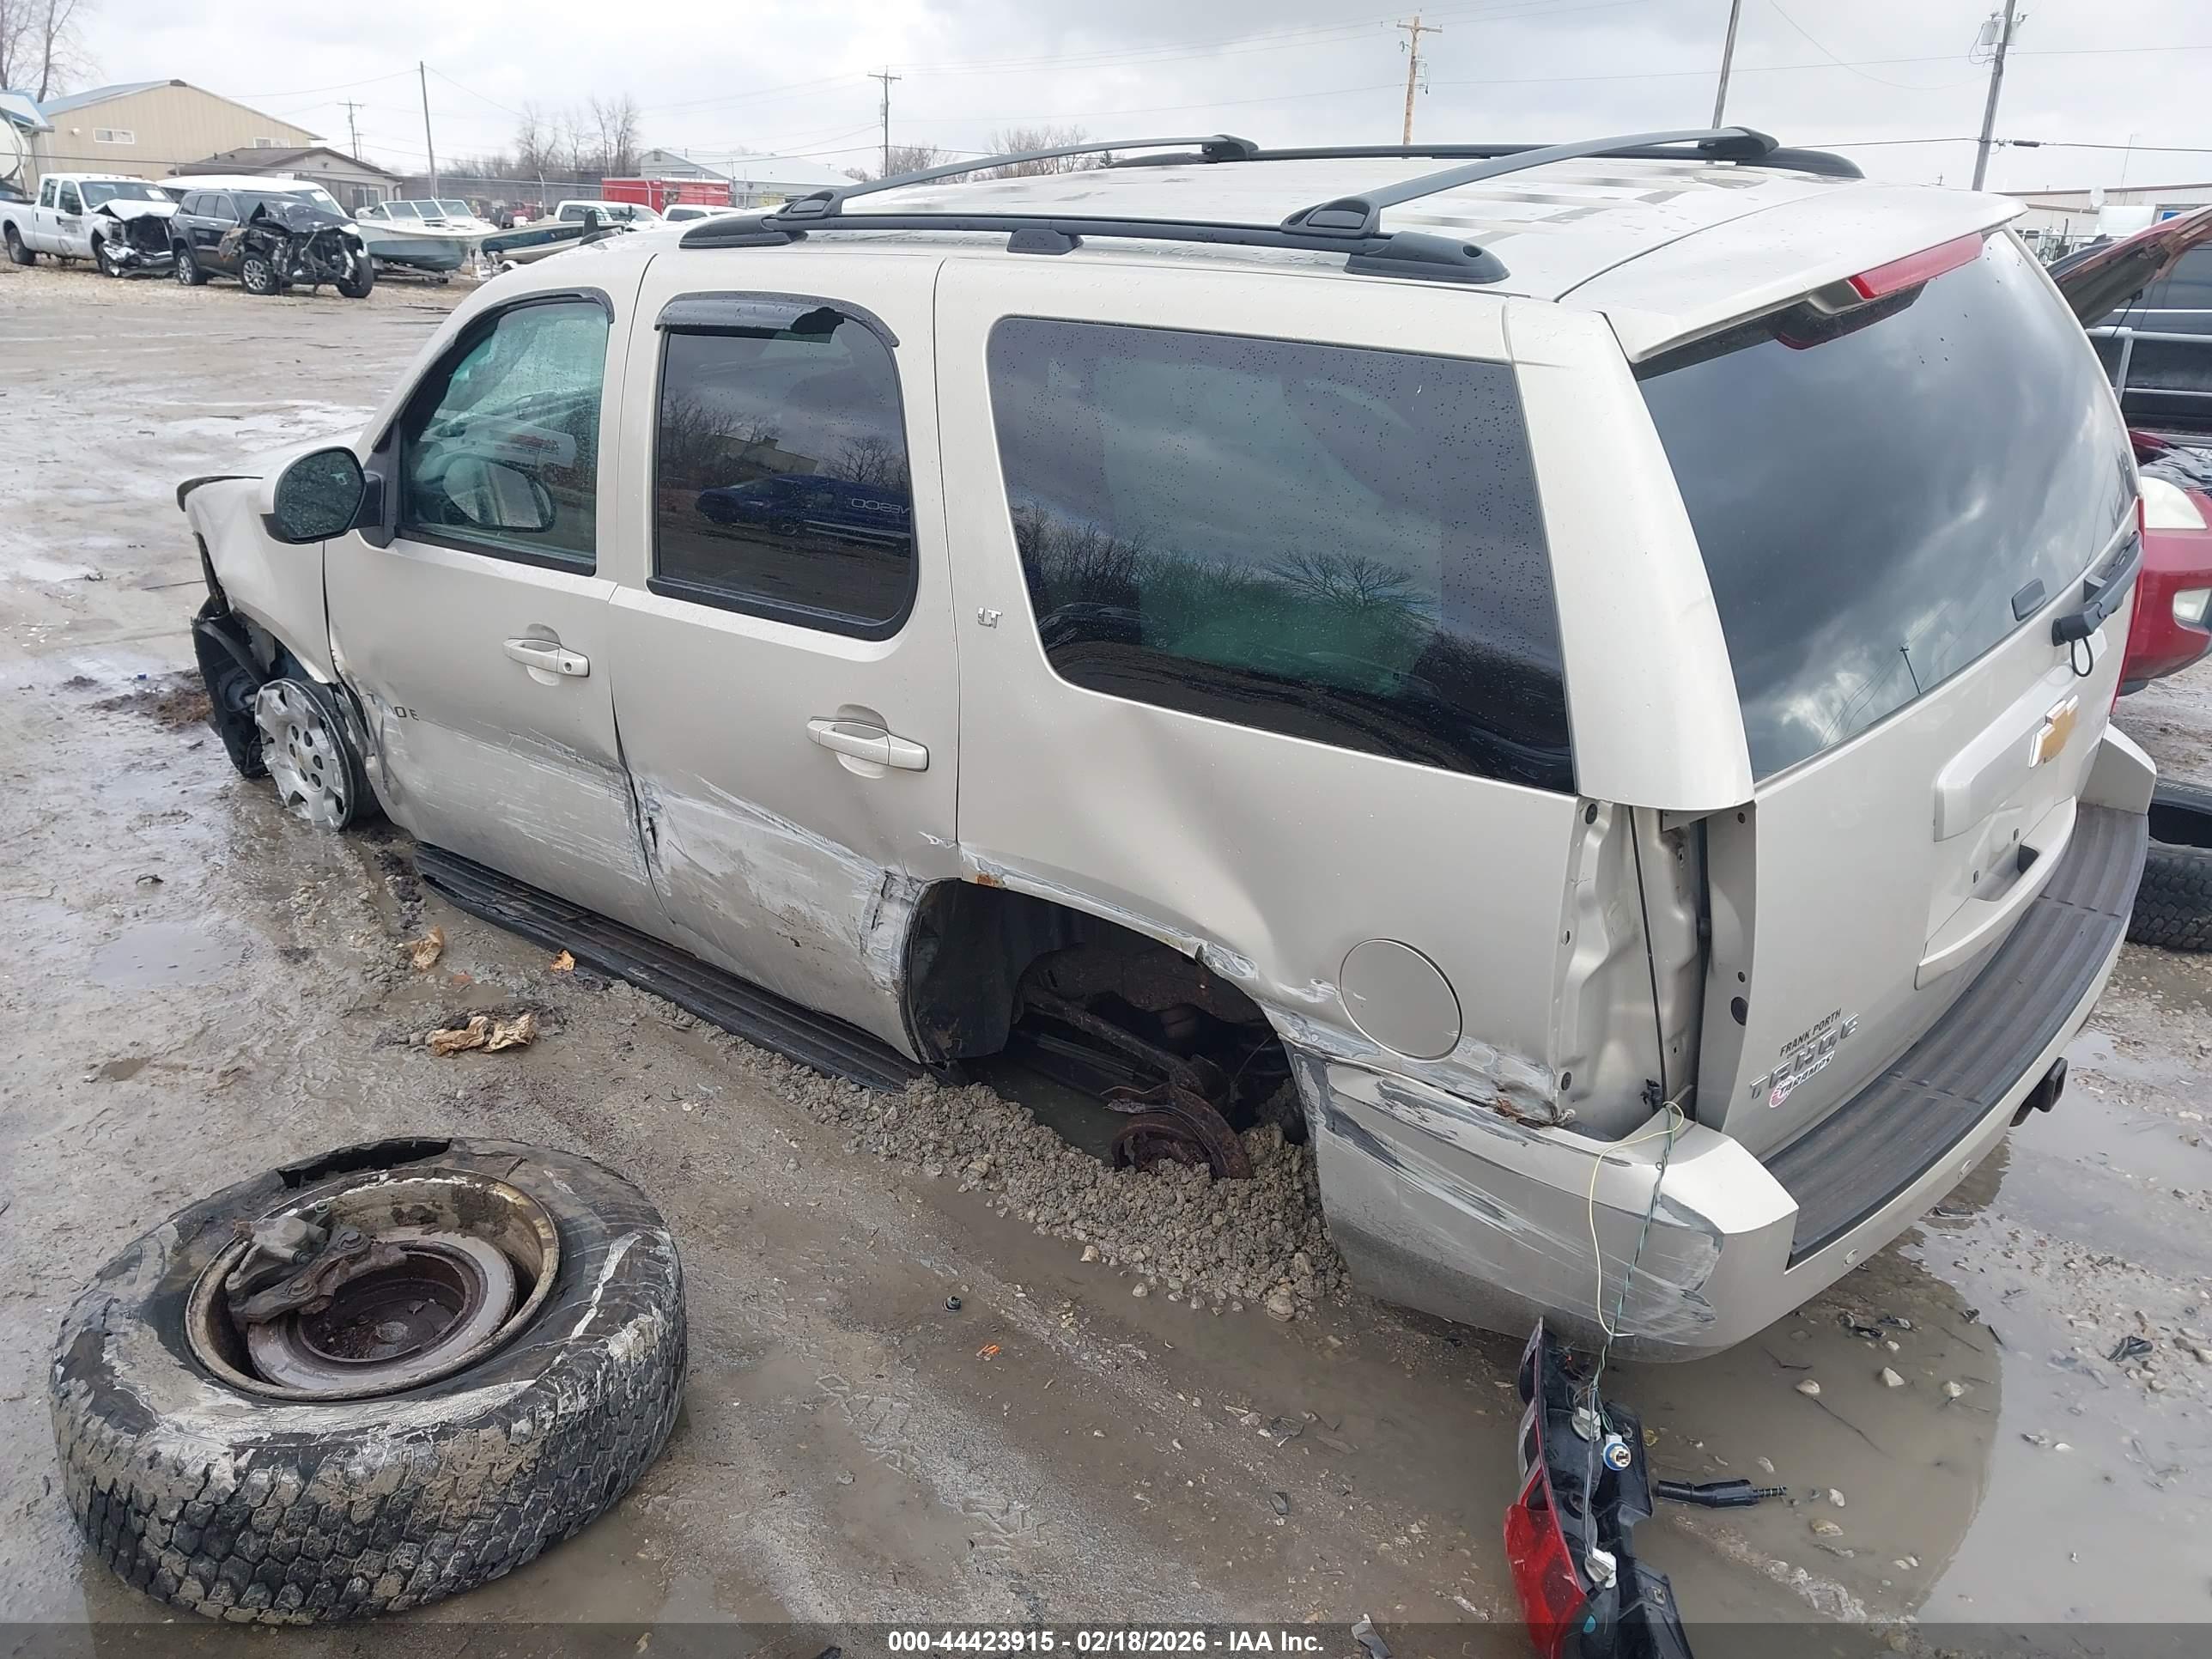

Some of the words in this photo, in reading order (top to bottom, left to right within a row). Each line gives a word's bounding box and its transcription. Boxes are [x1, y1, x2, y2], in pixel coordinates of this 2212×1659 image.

[977, 607, 1003, 629] LT
[1779, 1029, 1812, 1057] FRANK
[1812, 1007, 1842, 1036] PORTH
